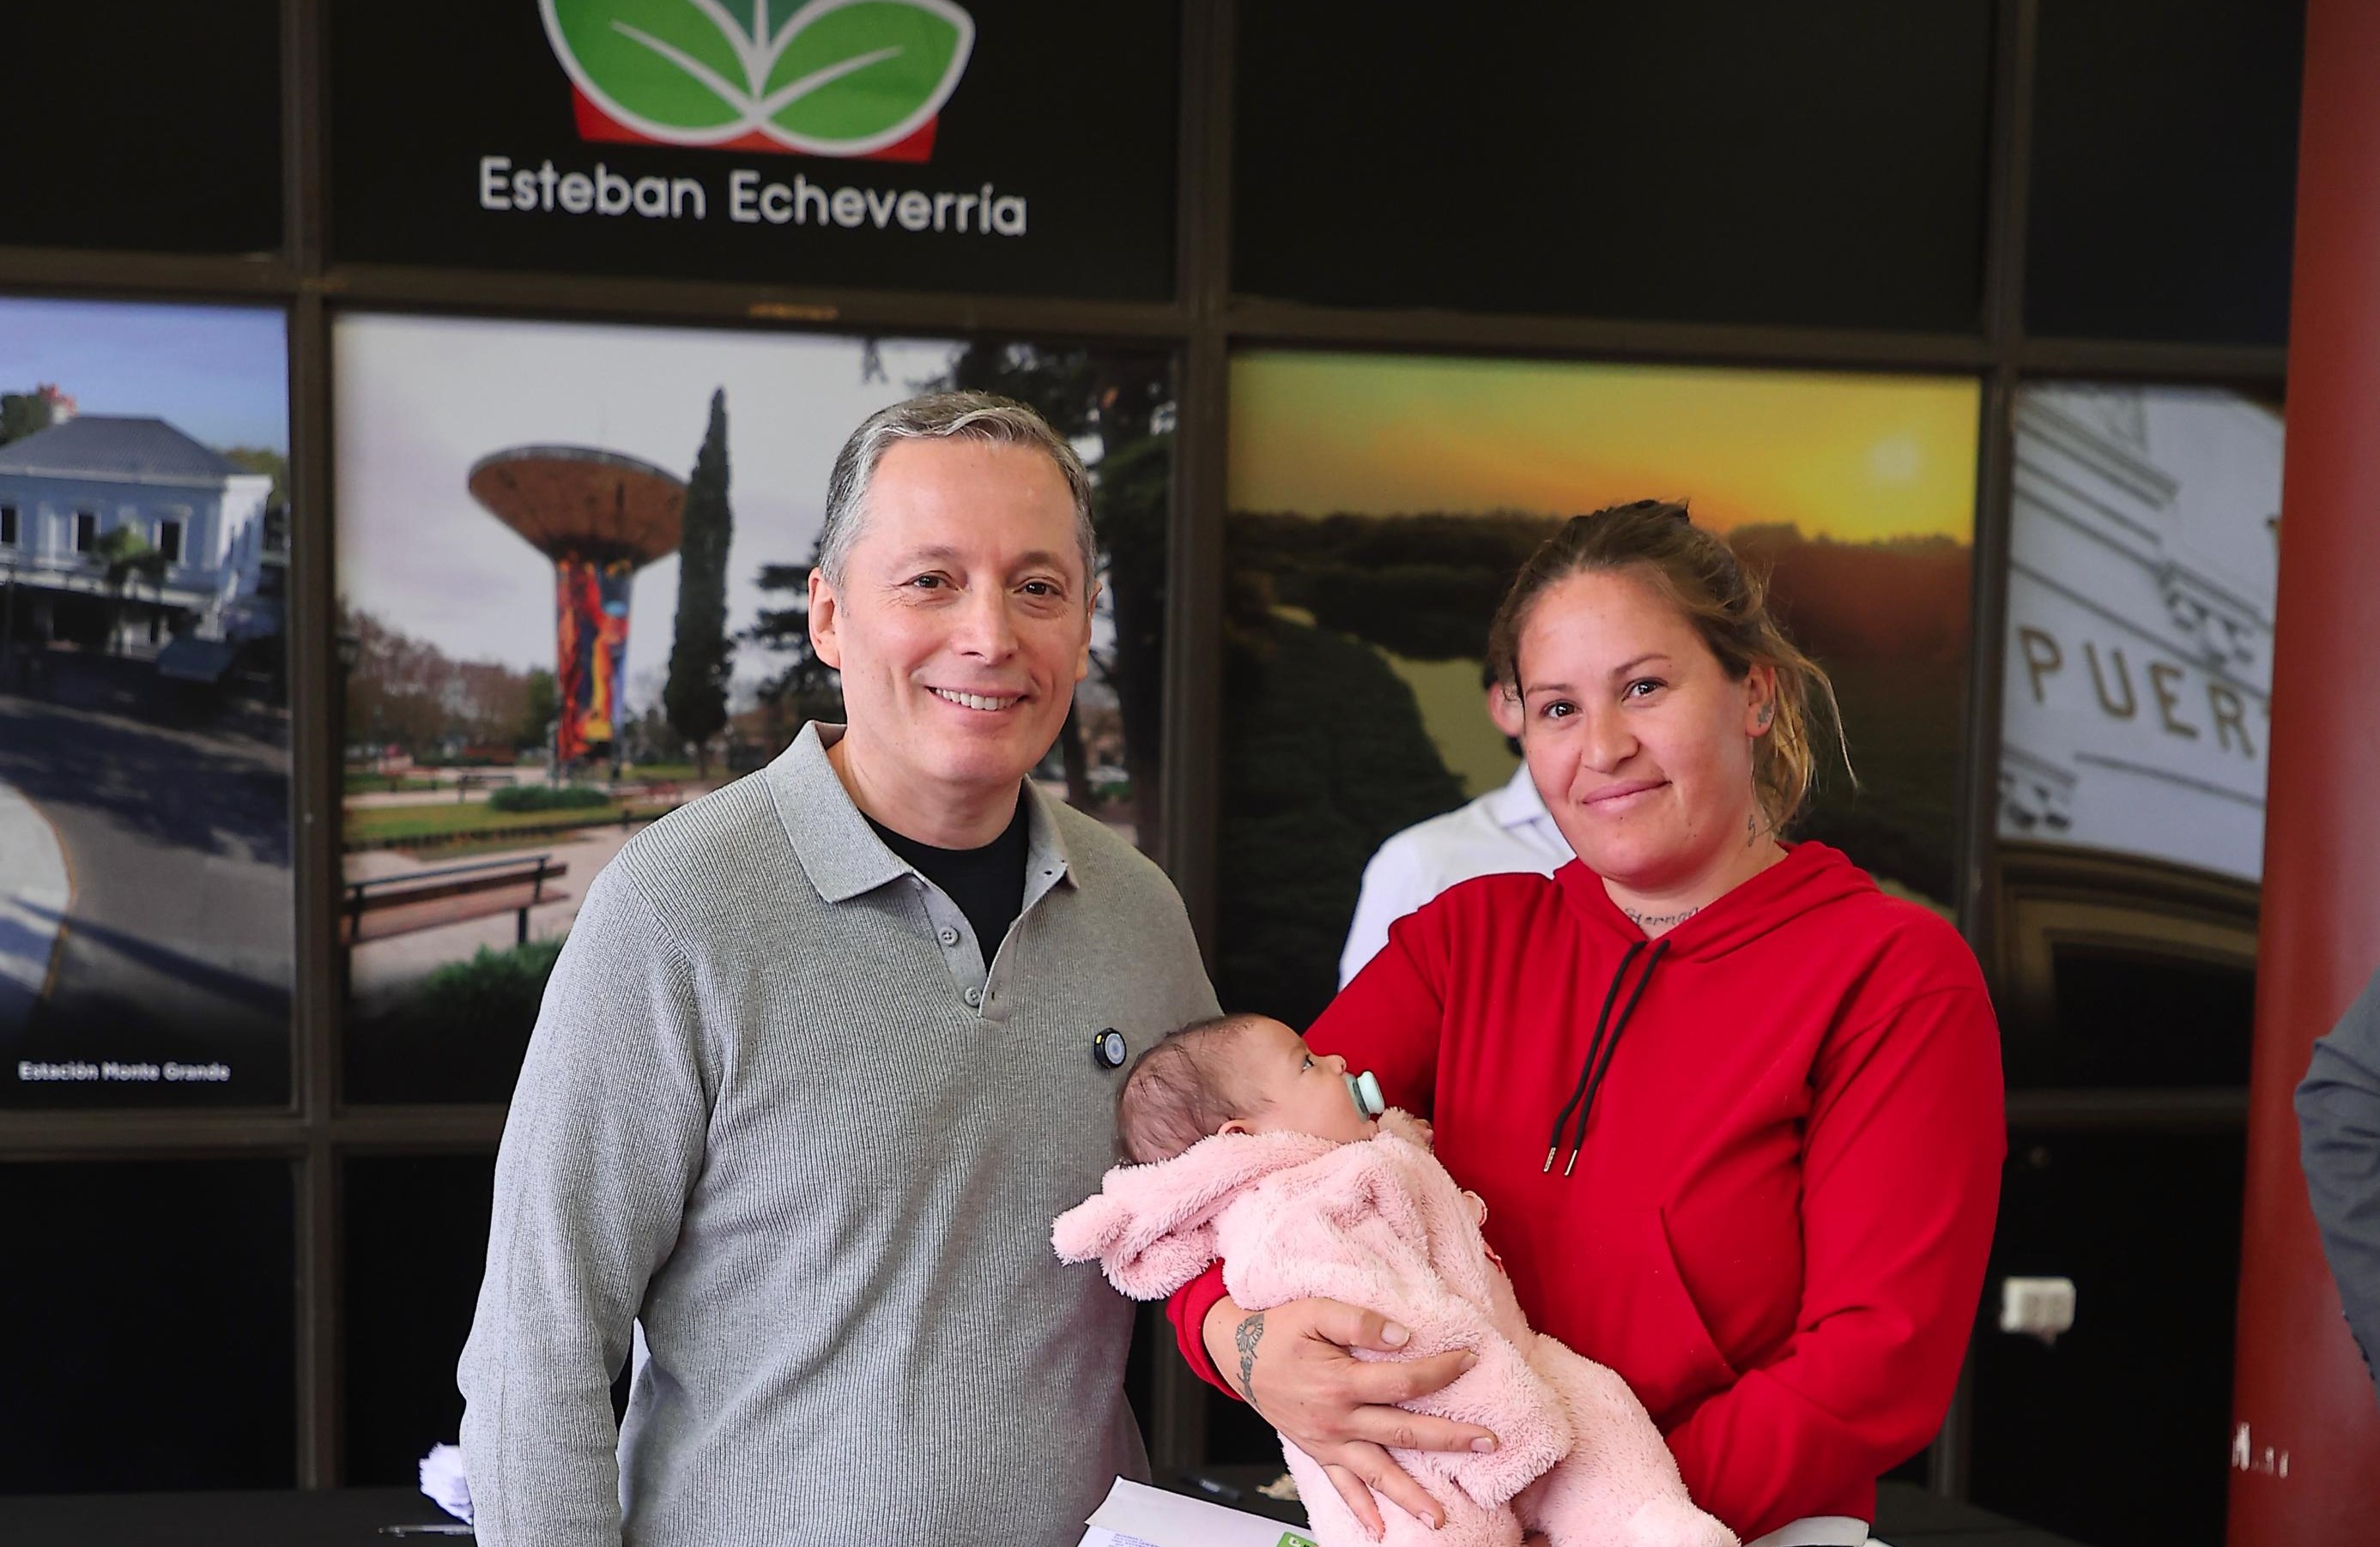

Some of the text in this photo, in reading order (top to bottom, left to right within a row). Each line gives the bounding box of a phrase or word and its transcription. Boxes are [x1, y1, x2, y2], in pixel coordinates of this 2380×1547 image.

[480, 157, 1026, 236] Esteban Echeverría
[2019, 626, 2268, 758] PUER
[18, 1061, 231, 1081] Estación Monte Grande
